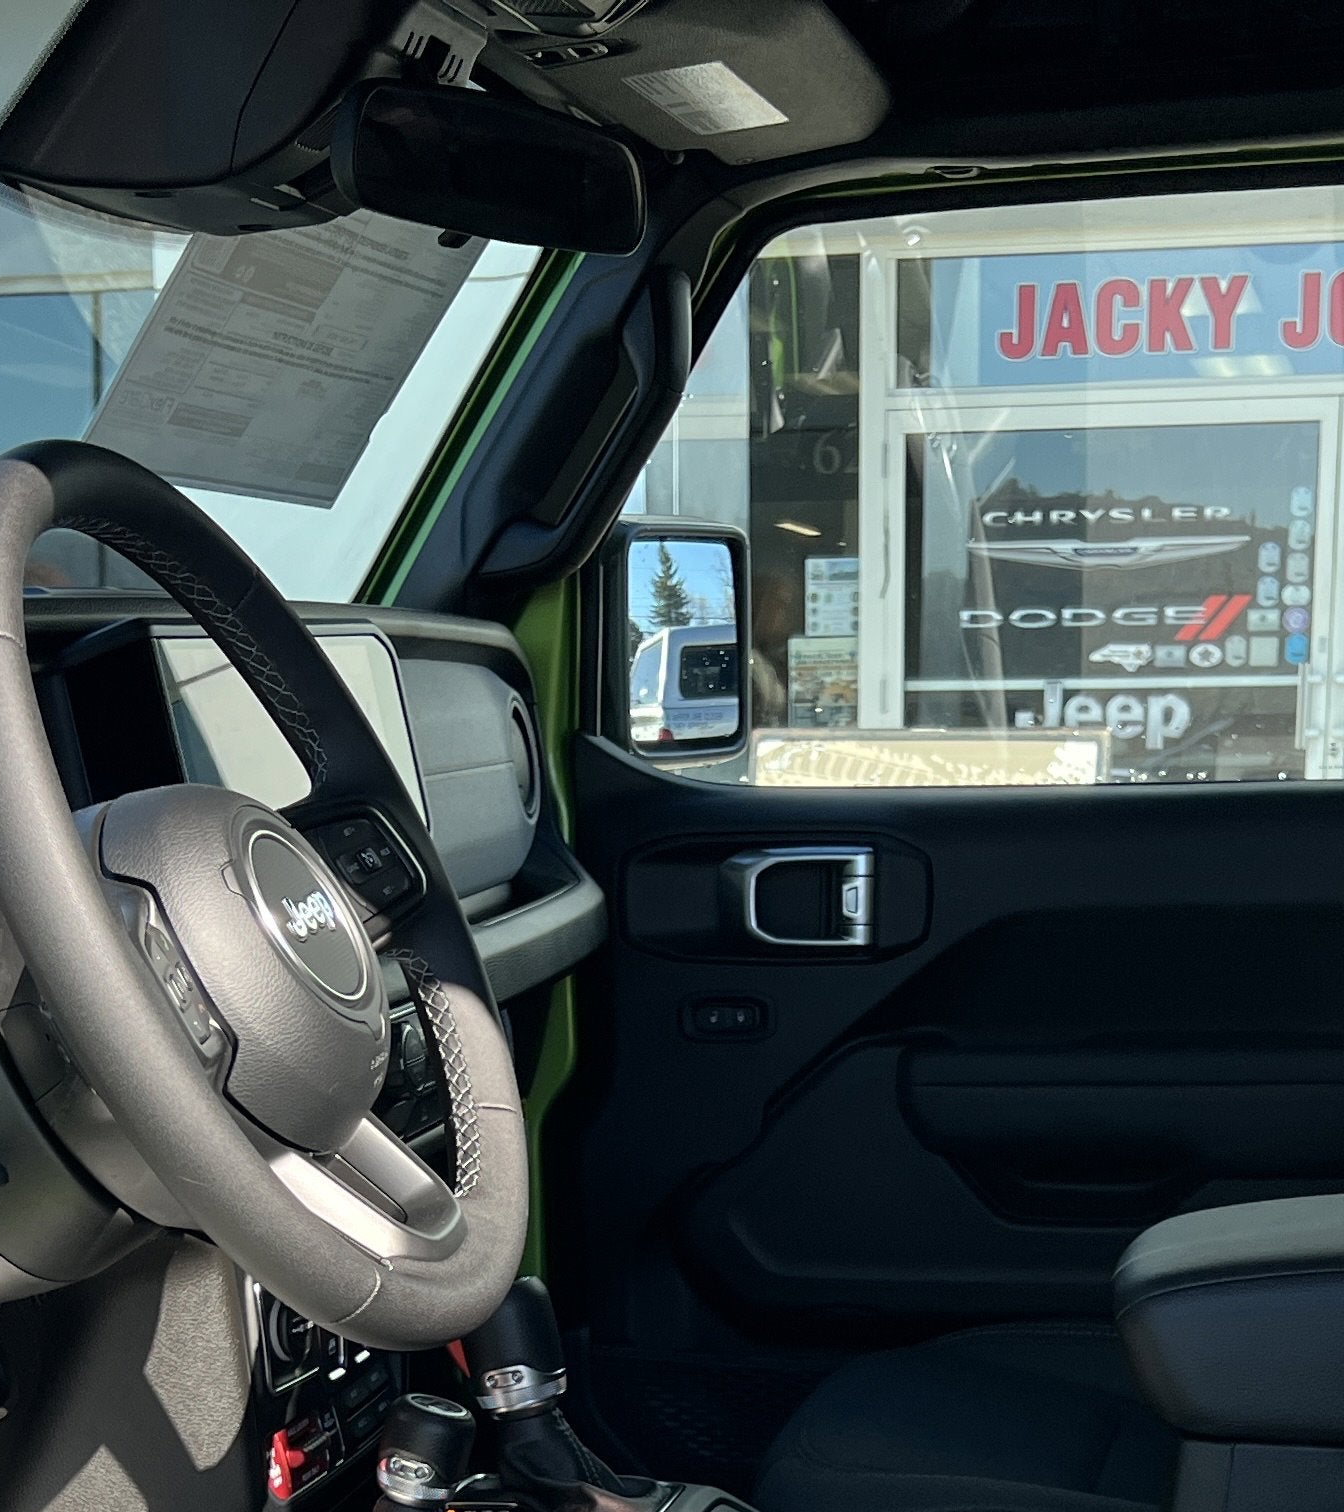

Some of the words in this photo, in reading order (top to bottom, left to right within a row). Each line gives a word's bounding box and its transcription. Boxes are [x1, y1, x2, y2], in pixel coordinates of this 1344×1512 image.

[998, 273, 1252, 362] JACKY
[981, 505, 1232, 528] CHRYSLER
[958, 604, 1208, 630] DODGE
[1014, 680, 1193, 750] Jeep
[282, 891, 337, 941] Jeep
